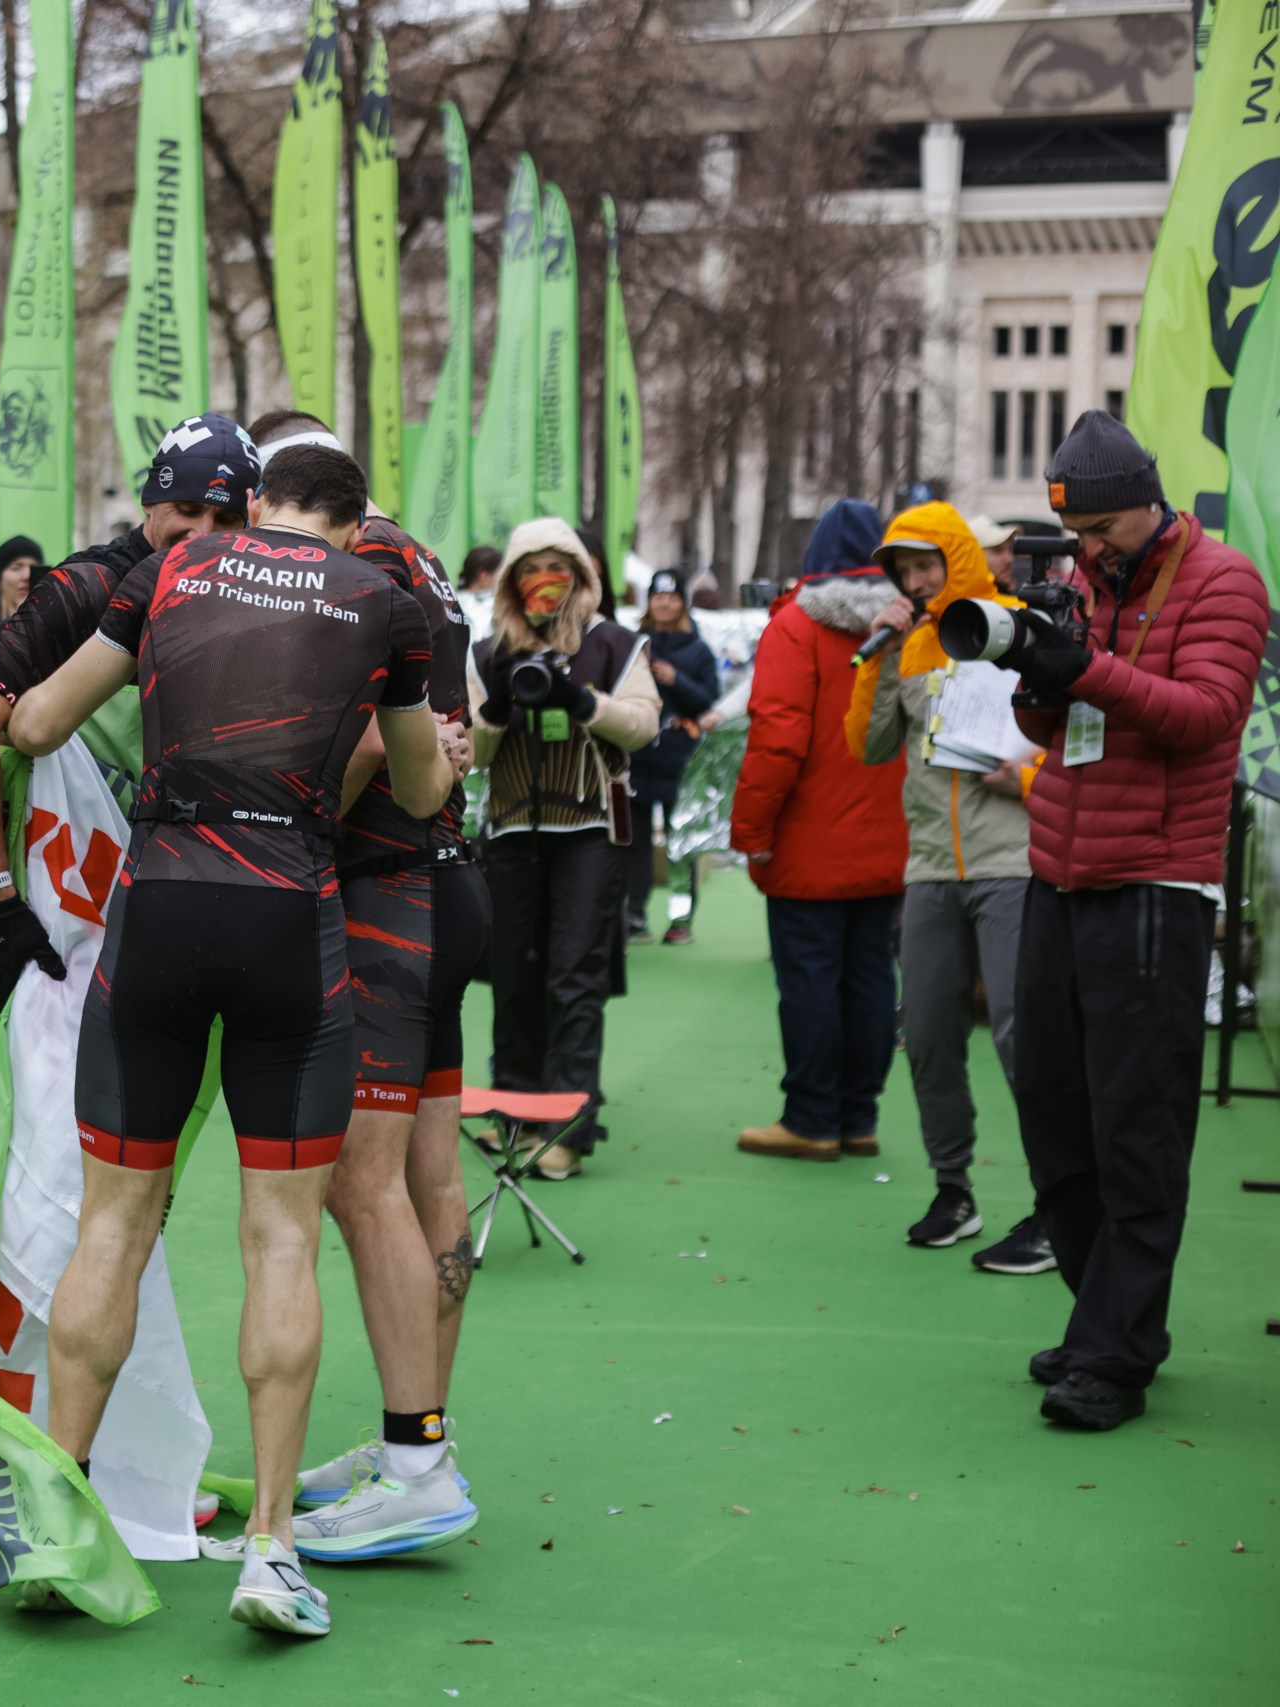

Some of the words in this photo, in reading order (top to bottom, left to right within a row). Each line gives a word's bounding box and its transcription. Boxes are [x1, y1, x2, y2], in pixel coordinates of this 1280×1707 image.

[217, 556, 325, 592] KHARIN
[176, 577, 211, 596] RZD
[217, 582, 306, 613] Triathlon
[312, 598, 360, 625] Team
[250, 811, 293, 827] Kalenji
[372, 1087, 407, 1103] Team
[77, 1127, 96, 1145] eam
